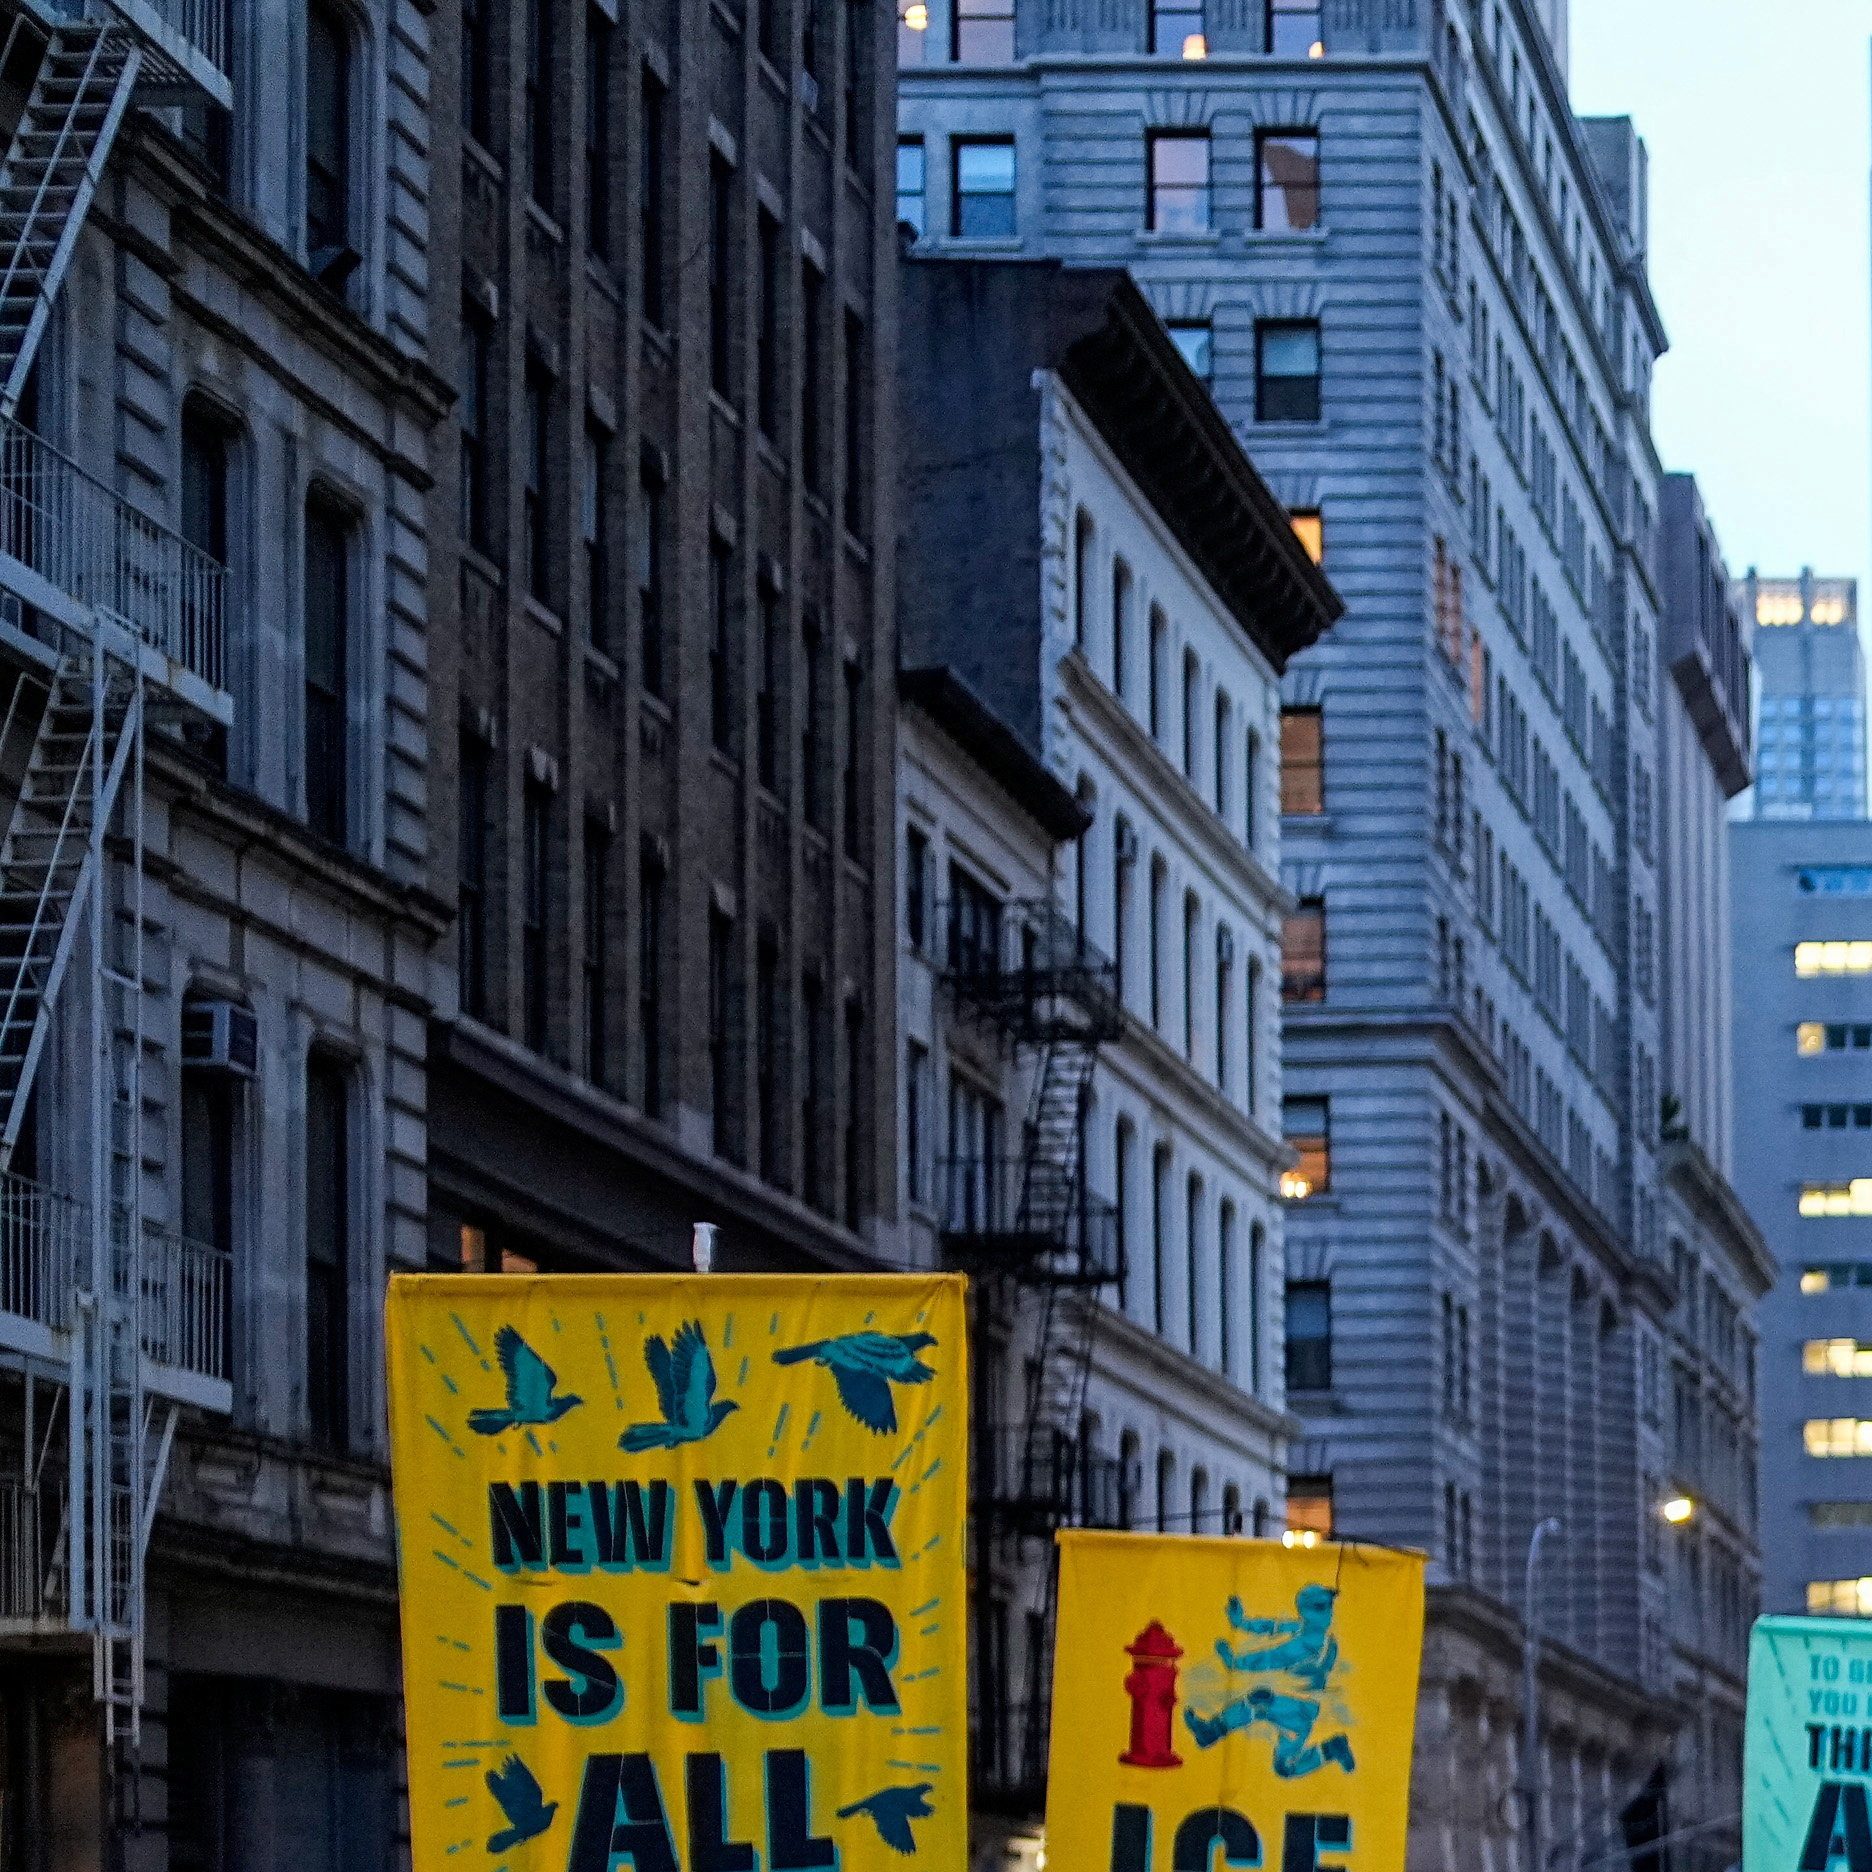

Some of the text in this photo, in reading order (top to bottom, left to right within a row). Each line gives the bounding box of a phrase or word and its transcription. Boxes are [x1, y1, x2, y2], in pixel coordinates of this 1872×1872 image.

[489, 1476, 900, 1574] NEW YORK
[498, 1597, 902, 1725] IS FOR
[1809, 1654, 1840, 1681] TO
[1809, 1690, 1857, 1716] YOU
